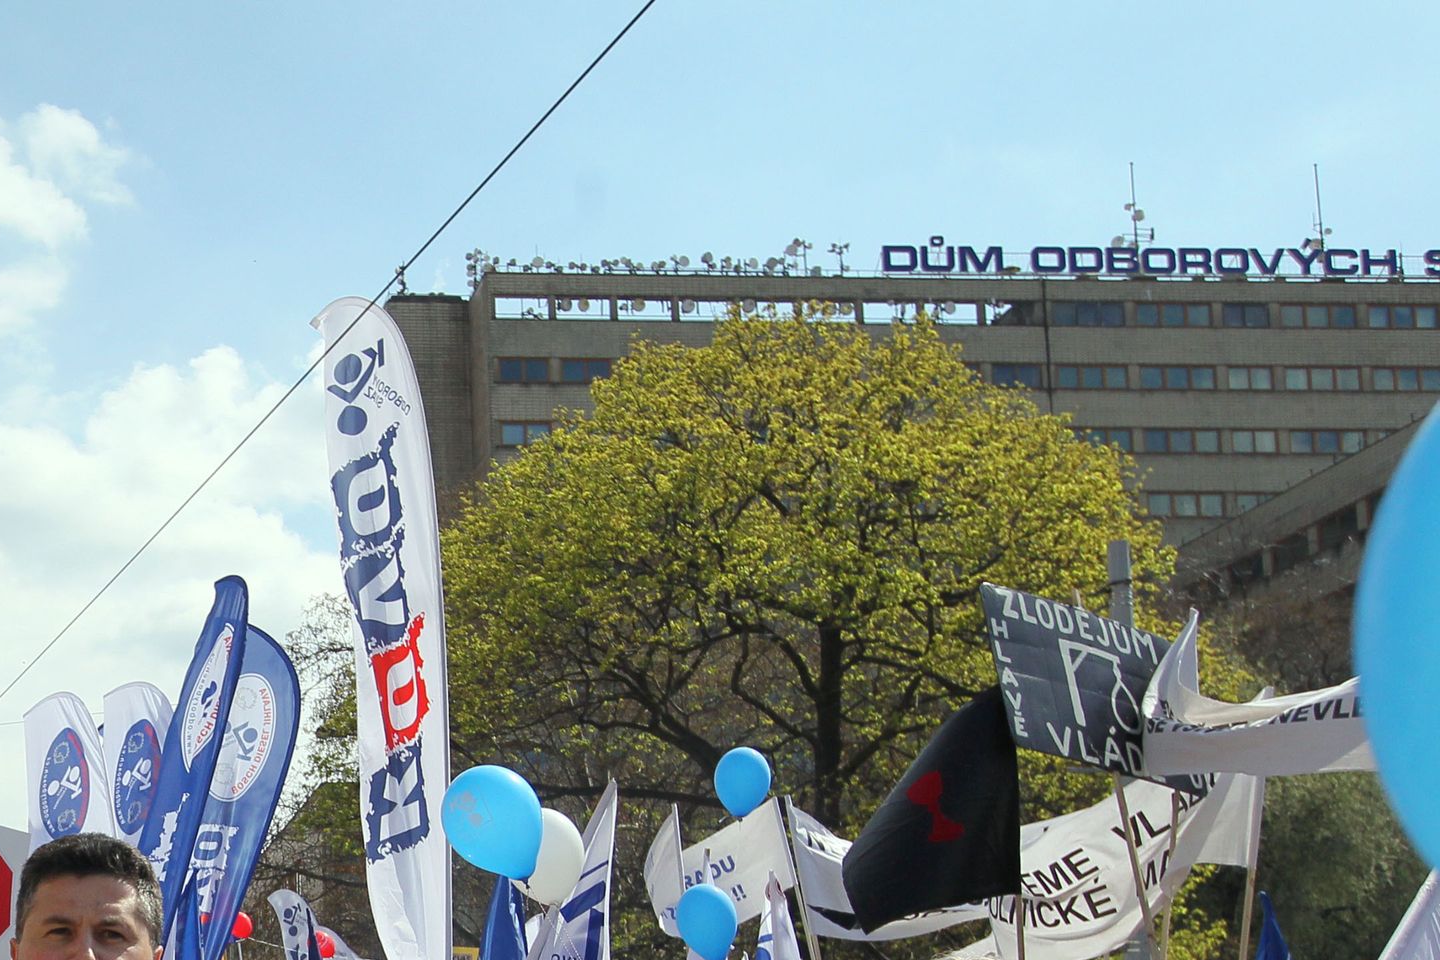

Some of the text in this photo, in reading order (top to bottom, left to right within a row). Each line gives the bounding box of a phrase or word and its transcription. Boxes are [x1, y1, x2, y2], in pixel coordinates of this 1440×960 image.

[881, 235, 1006, 275] DŮM
[1030, 238, 1398, 277] ODBOROVÝCH
[1046, 722, 1147, 777] VLÁD
[987, 875, 1118, 929] OLITICKÉ
